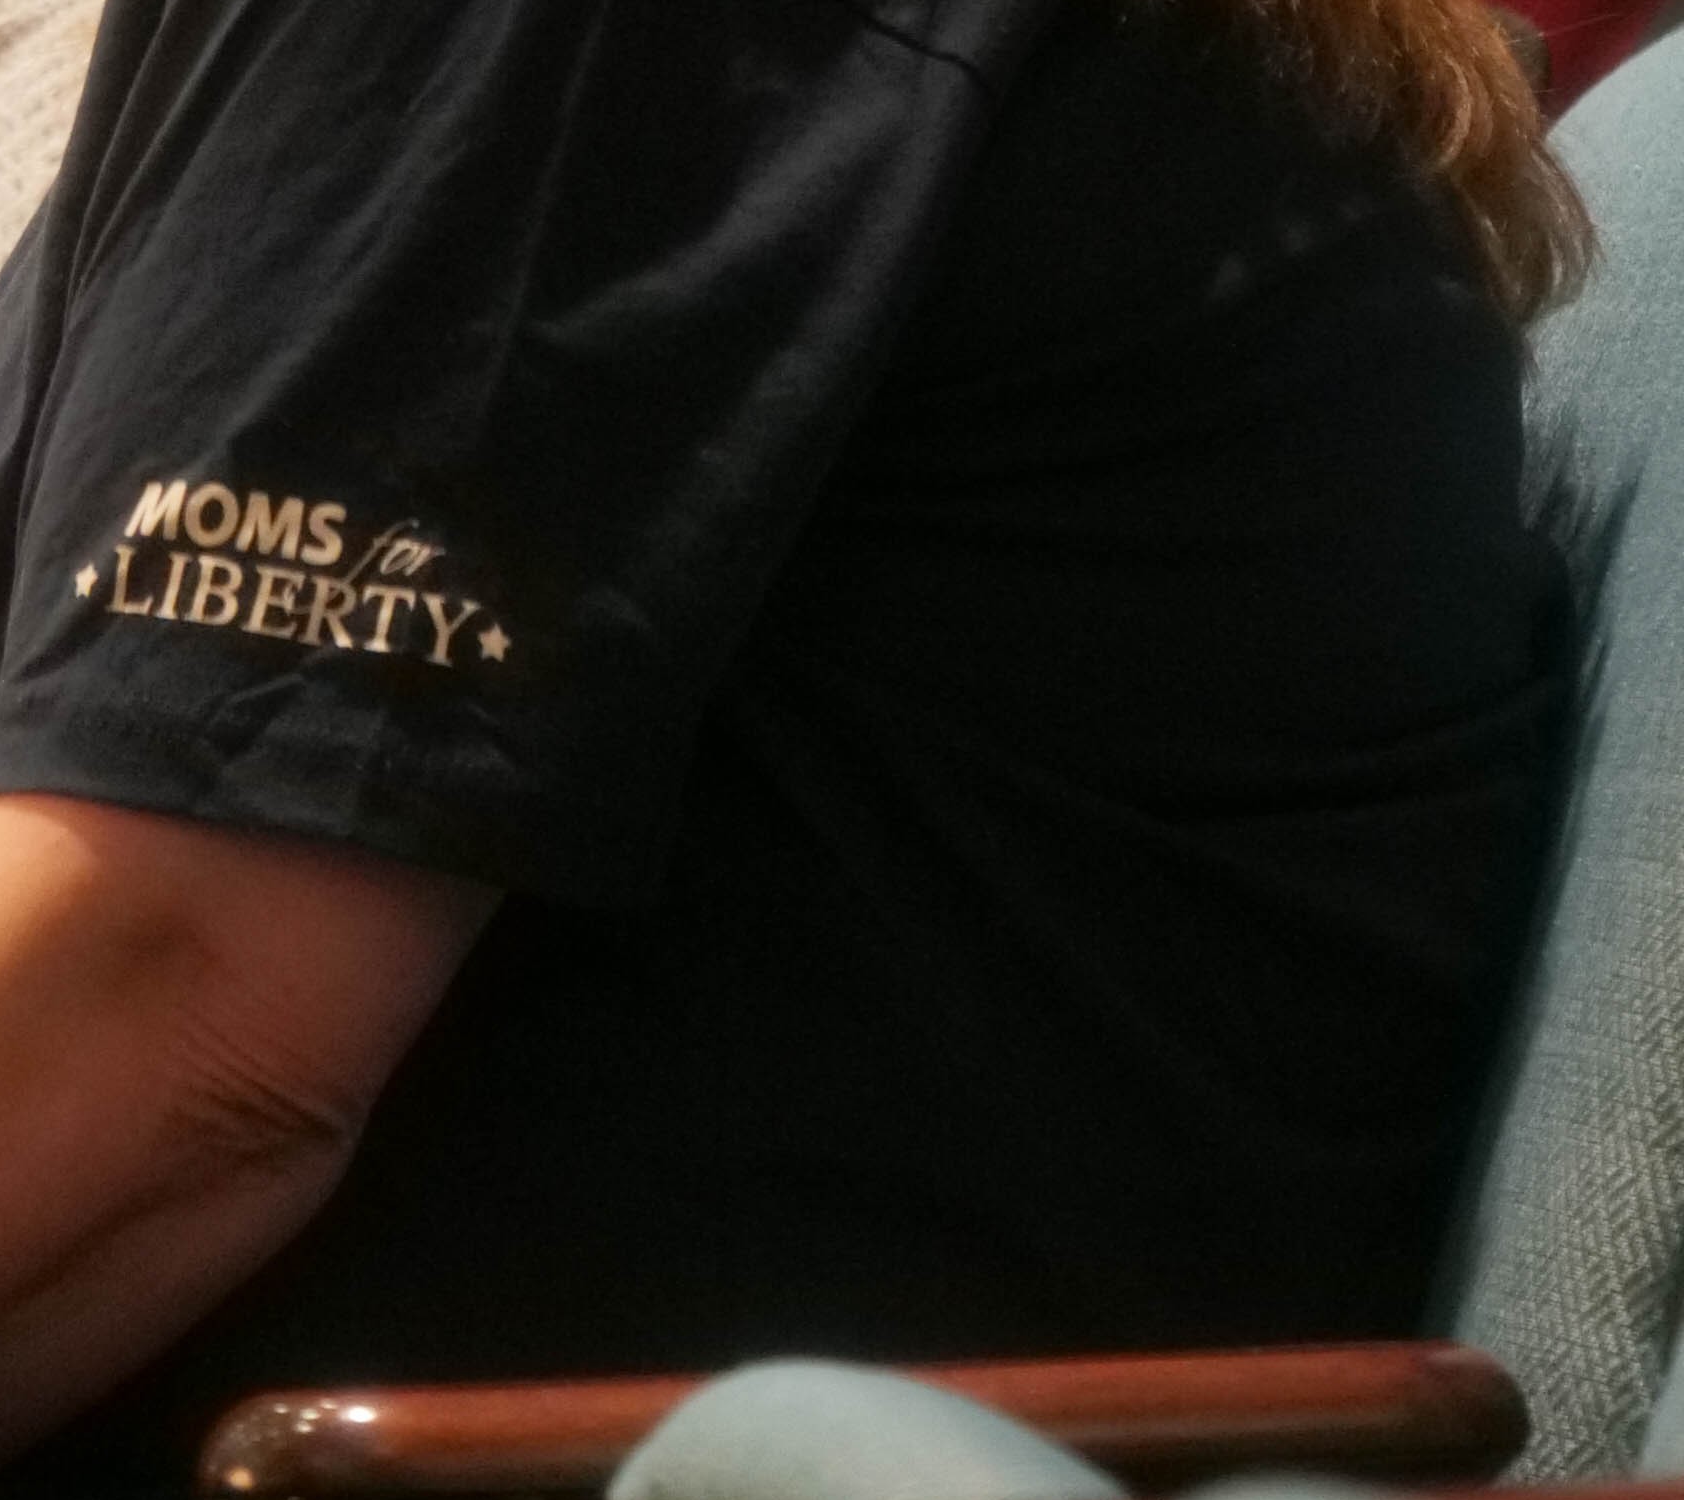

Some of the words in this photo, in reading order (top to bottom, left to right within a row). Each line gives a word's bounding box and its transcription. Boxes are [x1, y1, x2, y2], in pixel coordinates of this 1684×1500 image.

[124, 479, 347, 566] MOMS
[337, 517, 448, 588] for
[107, 544, 481, 667] LIBERTY
